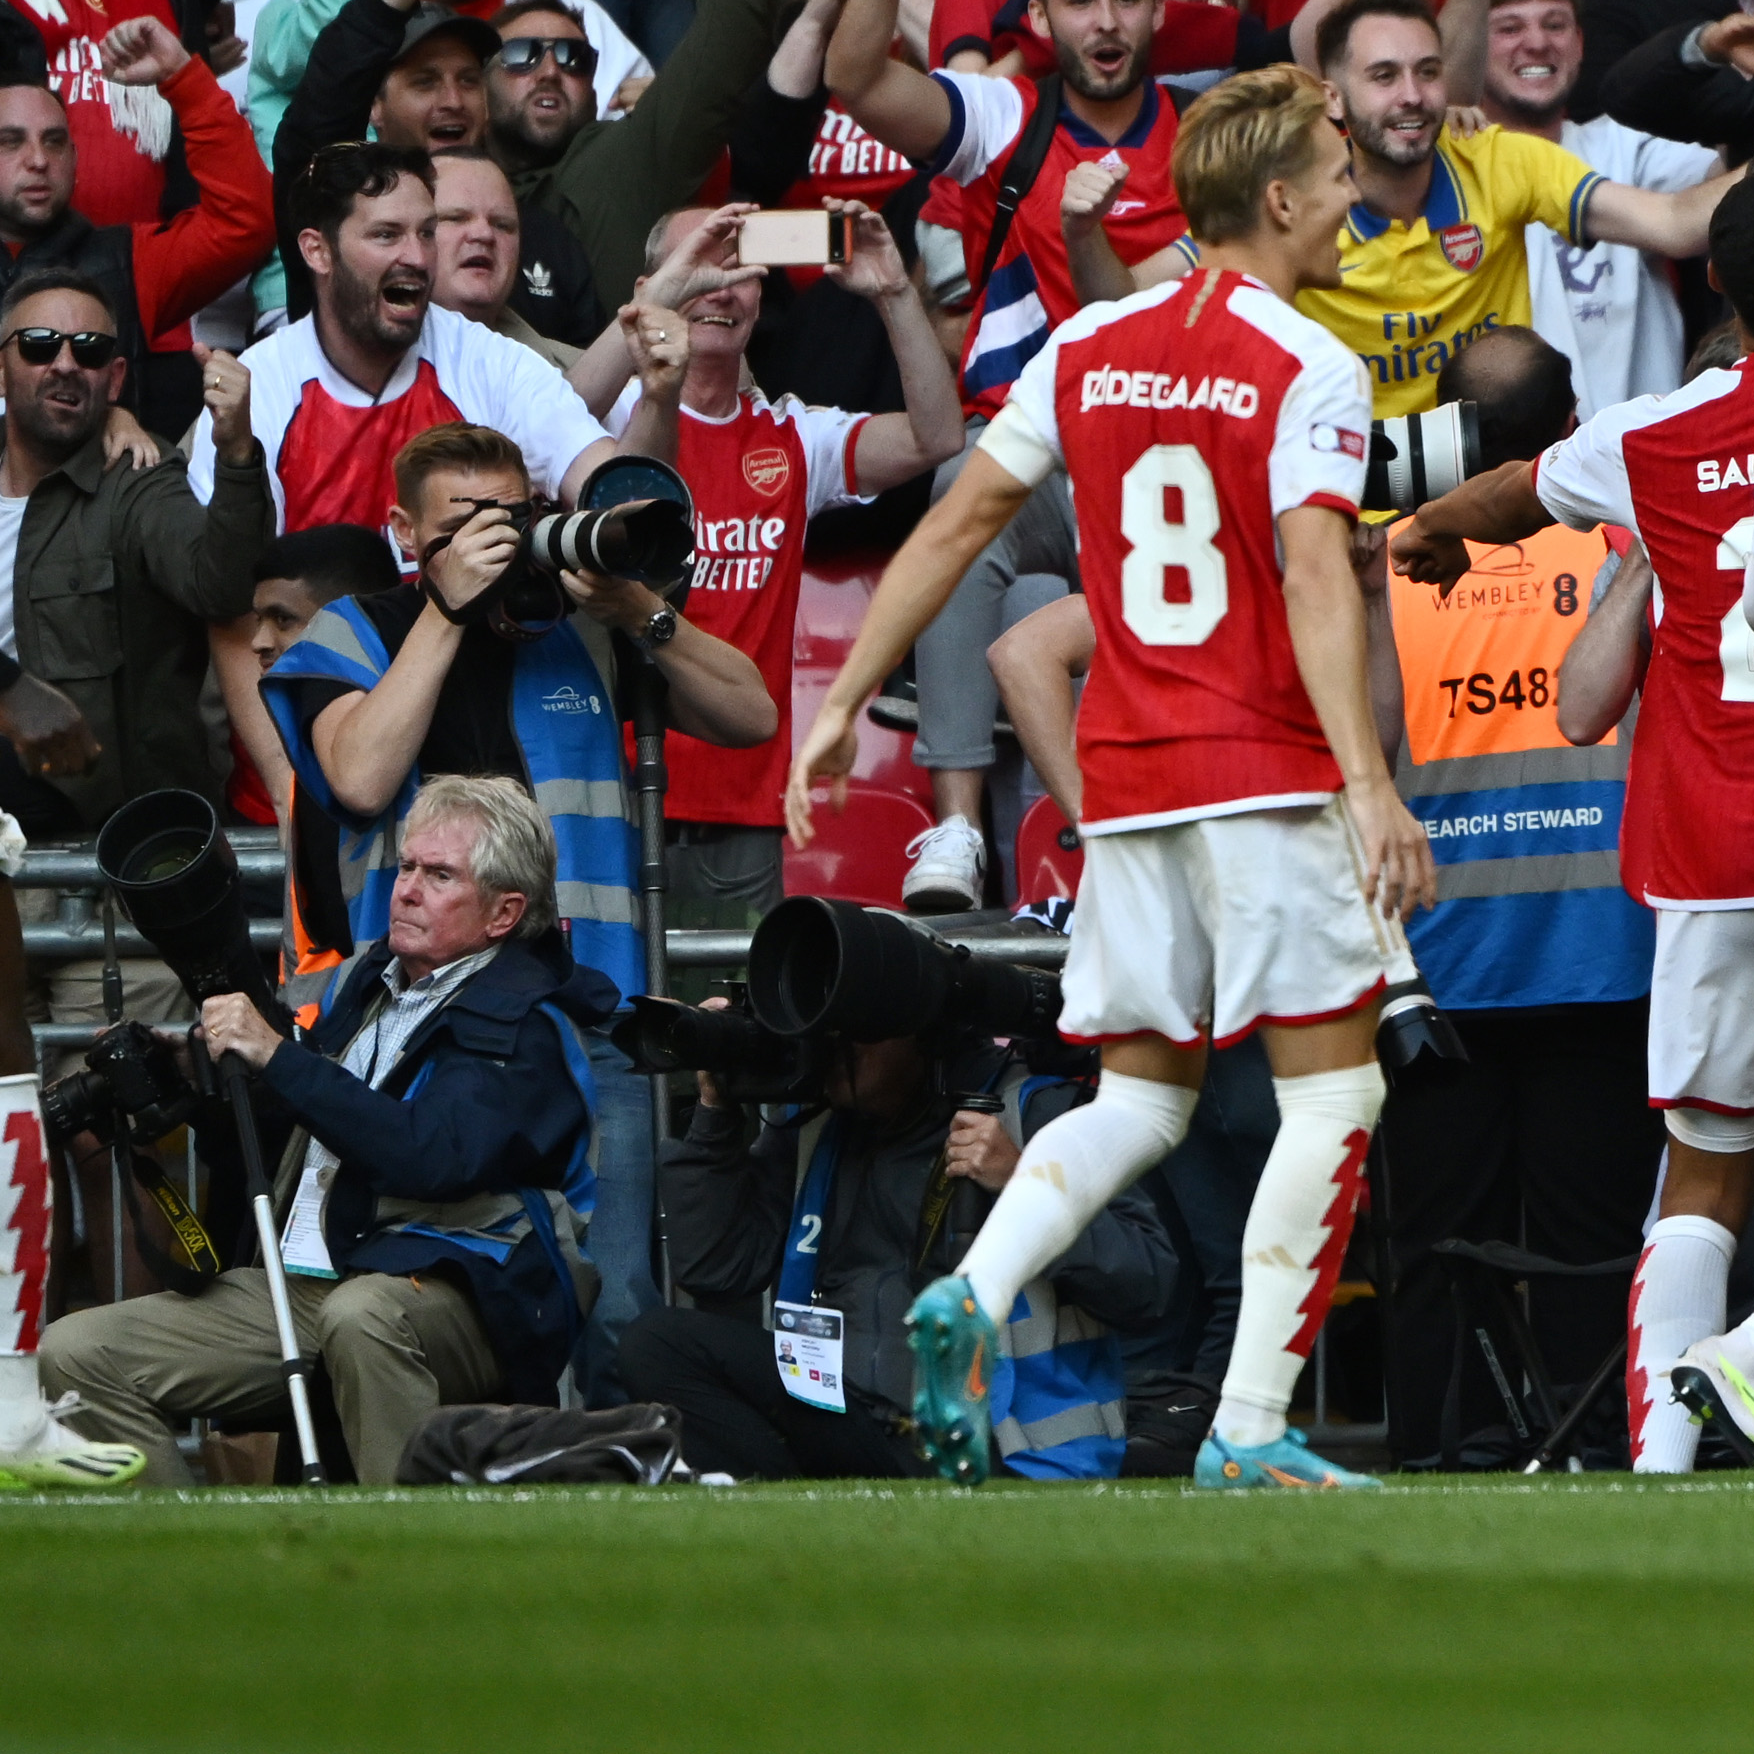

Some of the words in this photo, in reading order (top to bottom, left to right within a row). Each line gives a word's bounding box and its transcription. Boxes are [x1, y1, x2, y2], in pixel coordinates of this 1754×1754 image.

[1382, 312, 1443, 340] Fly
[1080, 364, 1259, 419] ØDEGAARD
[748, 457, 782, 470] Arsenal
[1121, 444, 1228, 646] 8
[1432, 581, 1544, 612] WEMBLEY
[542, 699, 587, 712] WEMBLEY
[1440, 667, 1559, 718] TS48
[1503, 807, 1602, 832] STEWARD
[796, 1214, 822, 1254] 2
